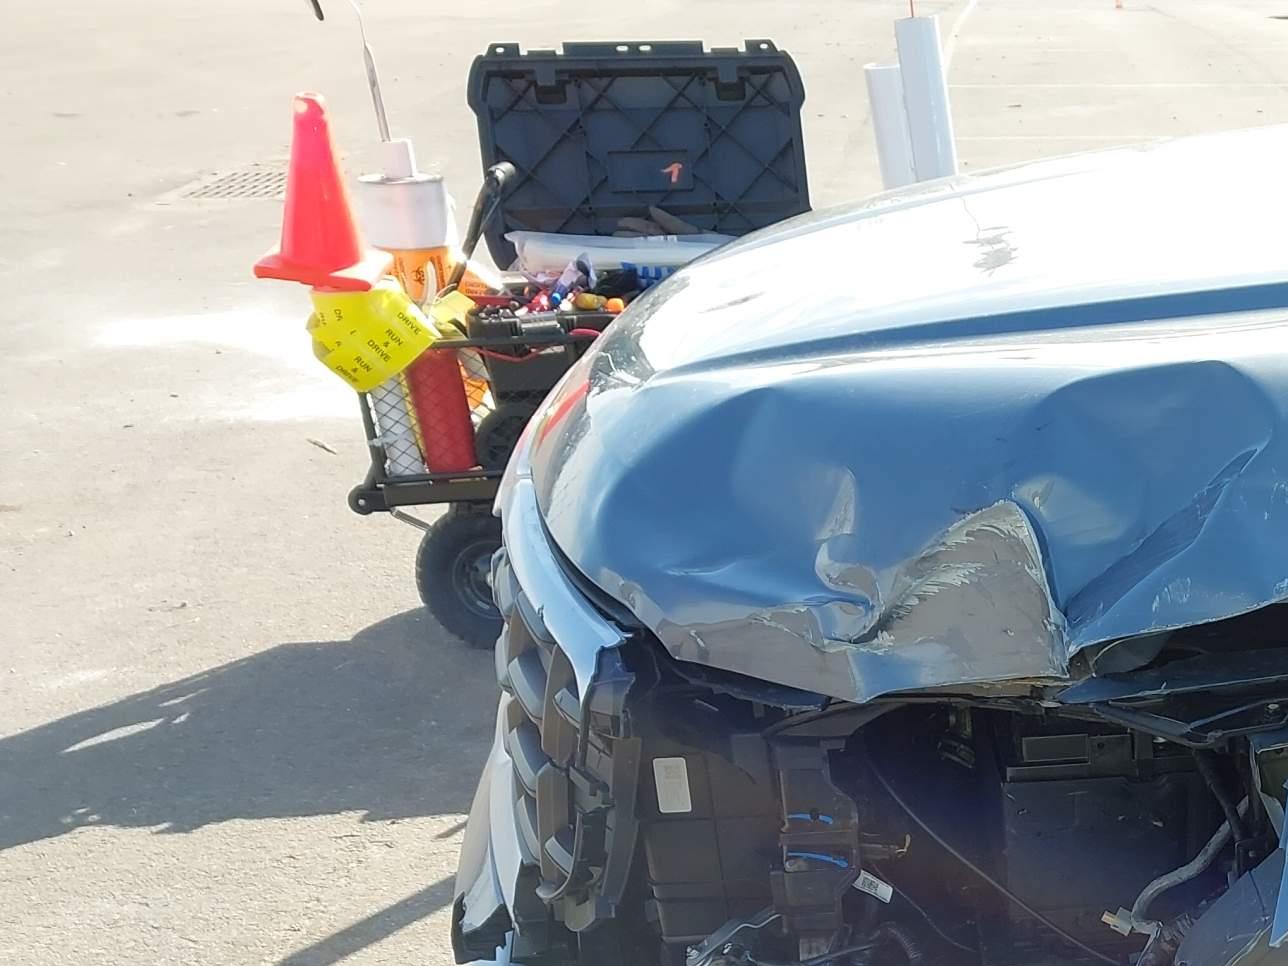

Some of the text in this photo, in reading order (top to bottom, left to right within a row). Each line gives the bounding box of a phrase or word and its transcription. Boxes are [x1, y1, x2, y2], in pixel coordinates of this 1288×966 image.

[397, 312, 422, 335] DRIVE
[385, 328, 403, 346] RUN
[367, 339, 391, 362] DRIVE
[354, 356, 373, 372] RUN
